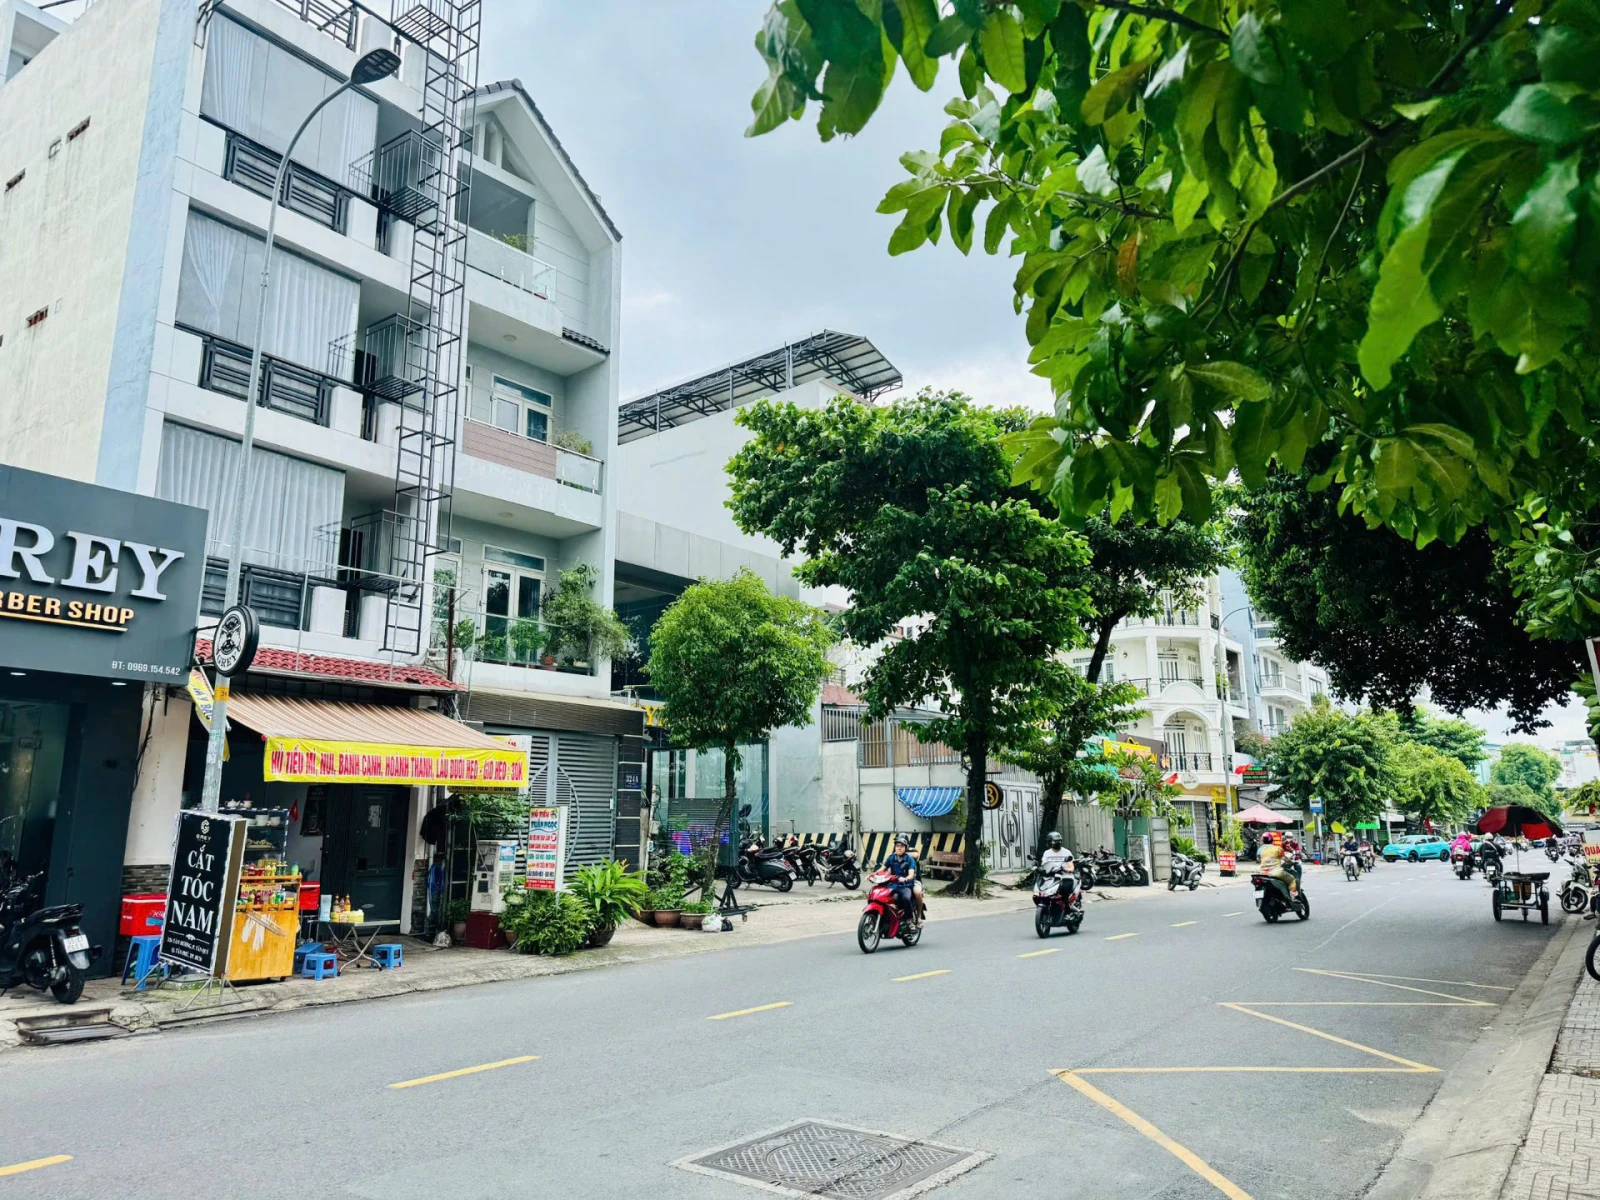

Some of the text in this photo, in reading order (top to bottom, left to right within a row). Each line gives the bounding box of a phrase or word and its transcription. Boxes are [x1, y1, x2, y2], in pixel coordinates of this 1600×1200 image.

[0, 590, 135, 625] BER SHOP
[127, 662, 181, 676] 0969.154.542
[216, 653, 237, 667] GREY
[338, 748, 360, 776] BÁNH
[385, 751, 410, 778] HOÀNH
[465, 759, 479, 780] HEO
[494, 760, 507, 781] HEO
[195, 833, 212, 841] GREY
[187, 844, 215, 872] CẮT
[181, 873, 215, 902] TÓC
[170, 900, 215, 935] NAM
